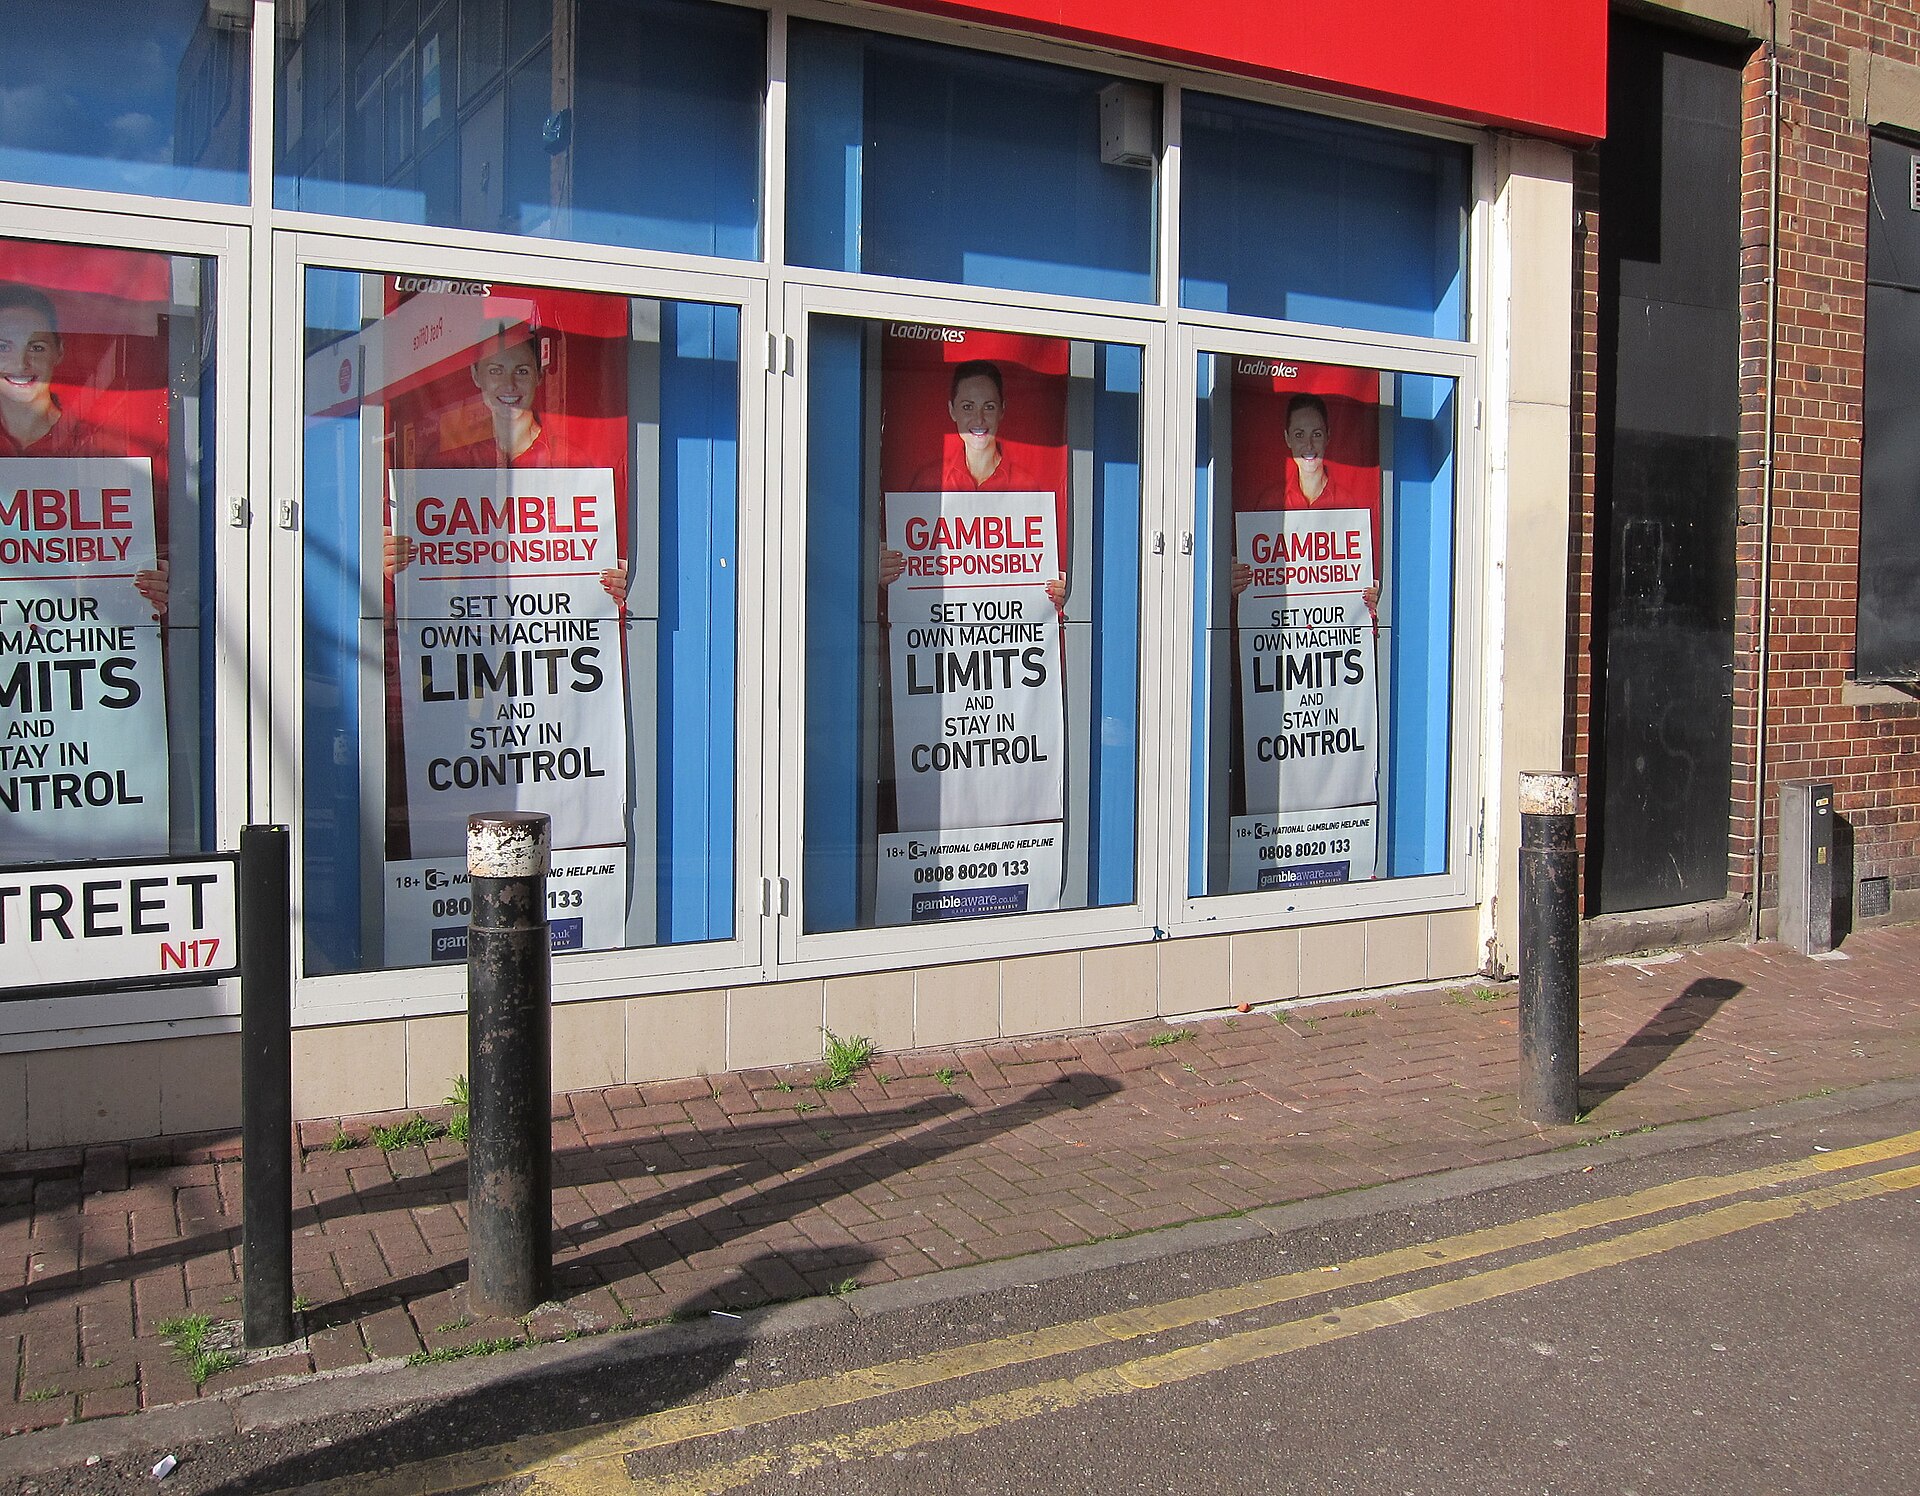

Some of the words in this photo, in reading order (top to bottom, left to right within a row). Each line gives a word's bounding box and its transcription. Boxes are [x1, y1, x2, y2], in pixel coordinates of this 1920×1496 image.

[890, 323, 966, 343] Ladbrokes
[1238, 360, 1298, 378] Ladbrokes
[415, 496, 598, 536] GAMBLE
[905, 516, 1043, 551] GAMBLE
[419, 539, 598, 565] RESPONSIBLY
[1251, 531, 1361, 564] GAMBLE
[908, 553, 1043, 576] RESPONSIBLY
[1254, 564, 1361, 587] RESPONSIBLY
[16, 597, 99, 624] YOUR
[449, 595, 497, 618] SET
[505, 593, 570, 616] YOUR
[930, 603, 967, 623] SET
[972, 601, 1023, 621] YOUR
[1271, 609, 1299, 627] SET
[1303, 606, 1344, 625] YOUR
[0, 626, 136, 655] MACHINE
[421, 623, 481, 648] OWN
[490, 620, 600, 645] MACHINE
[907, 628, 953, 648] OWN
[960, 623, 1044, 646] MACHINE
[1253, 633, 1292, 652] OWN
[1296, 627, 1362, 649] MACHINE
[420, 647, 603, 702] LIMITS
[907, 647, 1047, 695] LIMITS
[1253, 649, 1364, 693] LIMITS
[497, 703, 535, 720] AND
[965, 696, 993, 711] AND
[1299, 692, 1324, 707] AND
[7, 719, 55, 739] AND
[945, 715, 990, 737] STAY
[997, 713, 1015, 733] IN
[1283, 710, 1321, 730] STAY
[1325, 708, 1339, 726] IN
[470, 724, 530, 748] STAY
[539, 722, 562, 743] IN
[1257, 727, 1365, 762] CONTROL
[60, 741, 89, 767] IN
[911, 735, 1048, 773] CONTROL
[428, 747, 605, 791] CONTROL
[1236, 828, 1252, 838] 18+
[1271, 825, 1305, 835] NATIONAL
[1306, 822, 1340, 832] GAMBLING
[1341, 819, 1370, 829] HELPLINE
[886, 848, 905, 858] 18+
[930, 844, 970, 855] NATIONAL
[974, 840, 1014, 852] GAMBLING
[1017, 838, 1054, 848] HELPLINE
[1259, 844, 1292, 861] 0808
[1295, 841, 1326, 857] 8020
[1330, 839, 1350, 853] 133
[395, 877, 420, 888] 18+
[566, 864, 616, 878] HELPLINE
[914, 865, 954, 883] 0808
[958, 862, 998, 880] 8020
[1002, 860, 1029, 876] 133
[432, 898, 471, 917] 080
[548, 889, 583, 908] 133
[916, 894, 1018, 913] gambleaware.co.uk
[161, 938, 220, 970] N17
